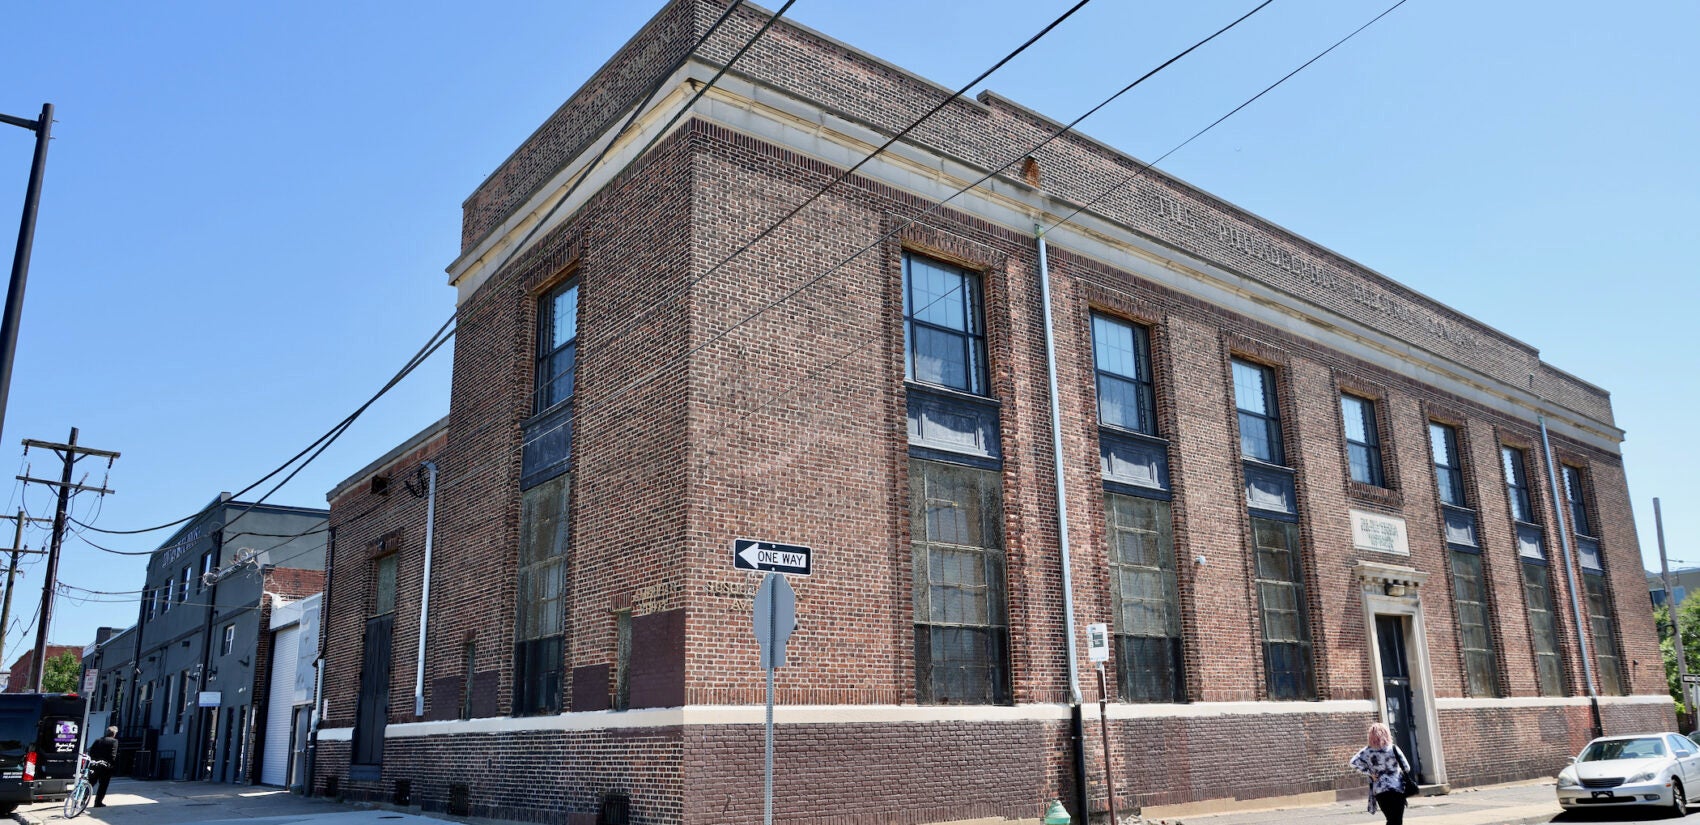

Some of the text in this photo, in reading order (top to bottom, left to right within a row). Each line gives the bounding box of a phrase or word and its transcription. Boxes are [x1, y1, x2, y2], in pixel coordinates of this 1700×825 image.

[1156, 194, 1195, 228] THE
[1218, 222, 1336, 289] PHILADELPHIA
[758, 551, 803, 566] ONE WAY
